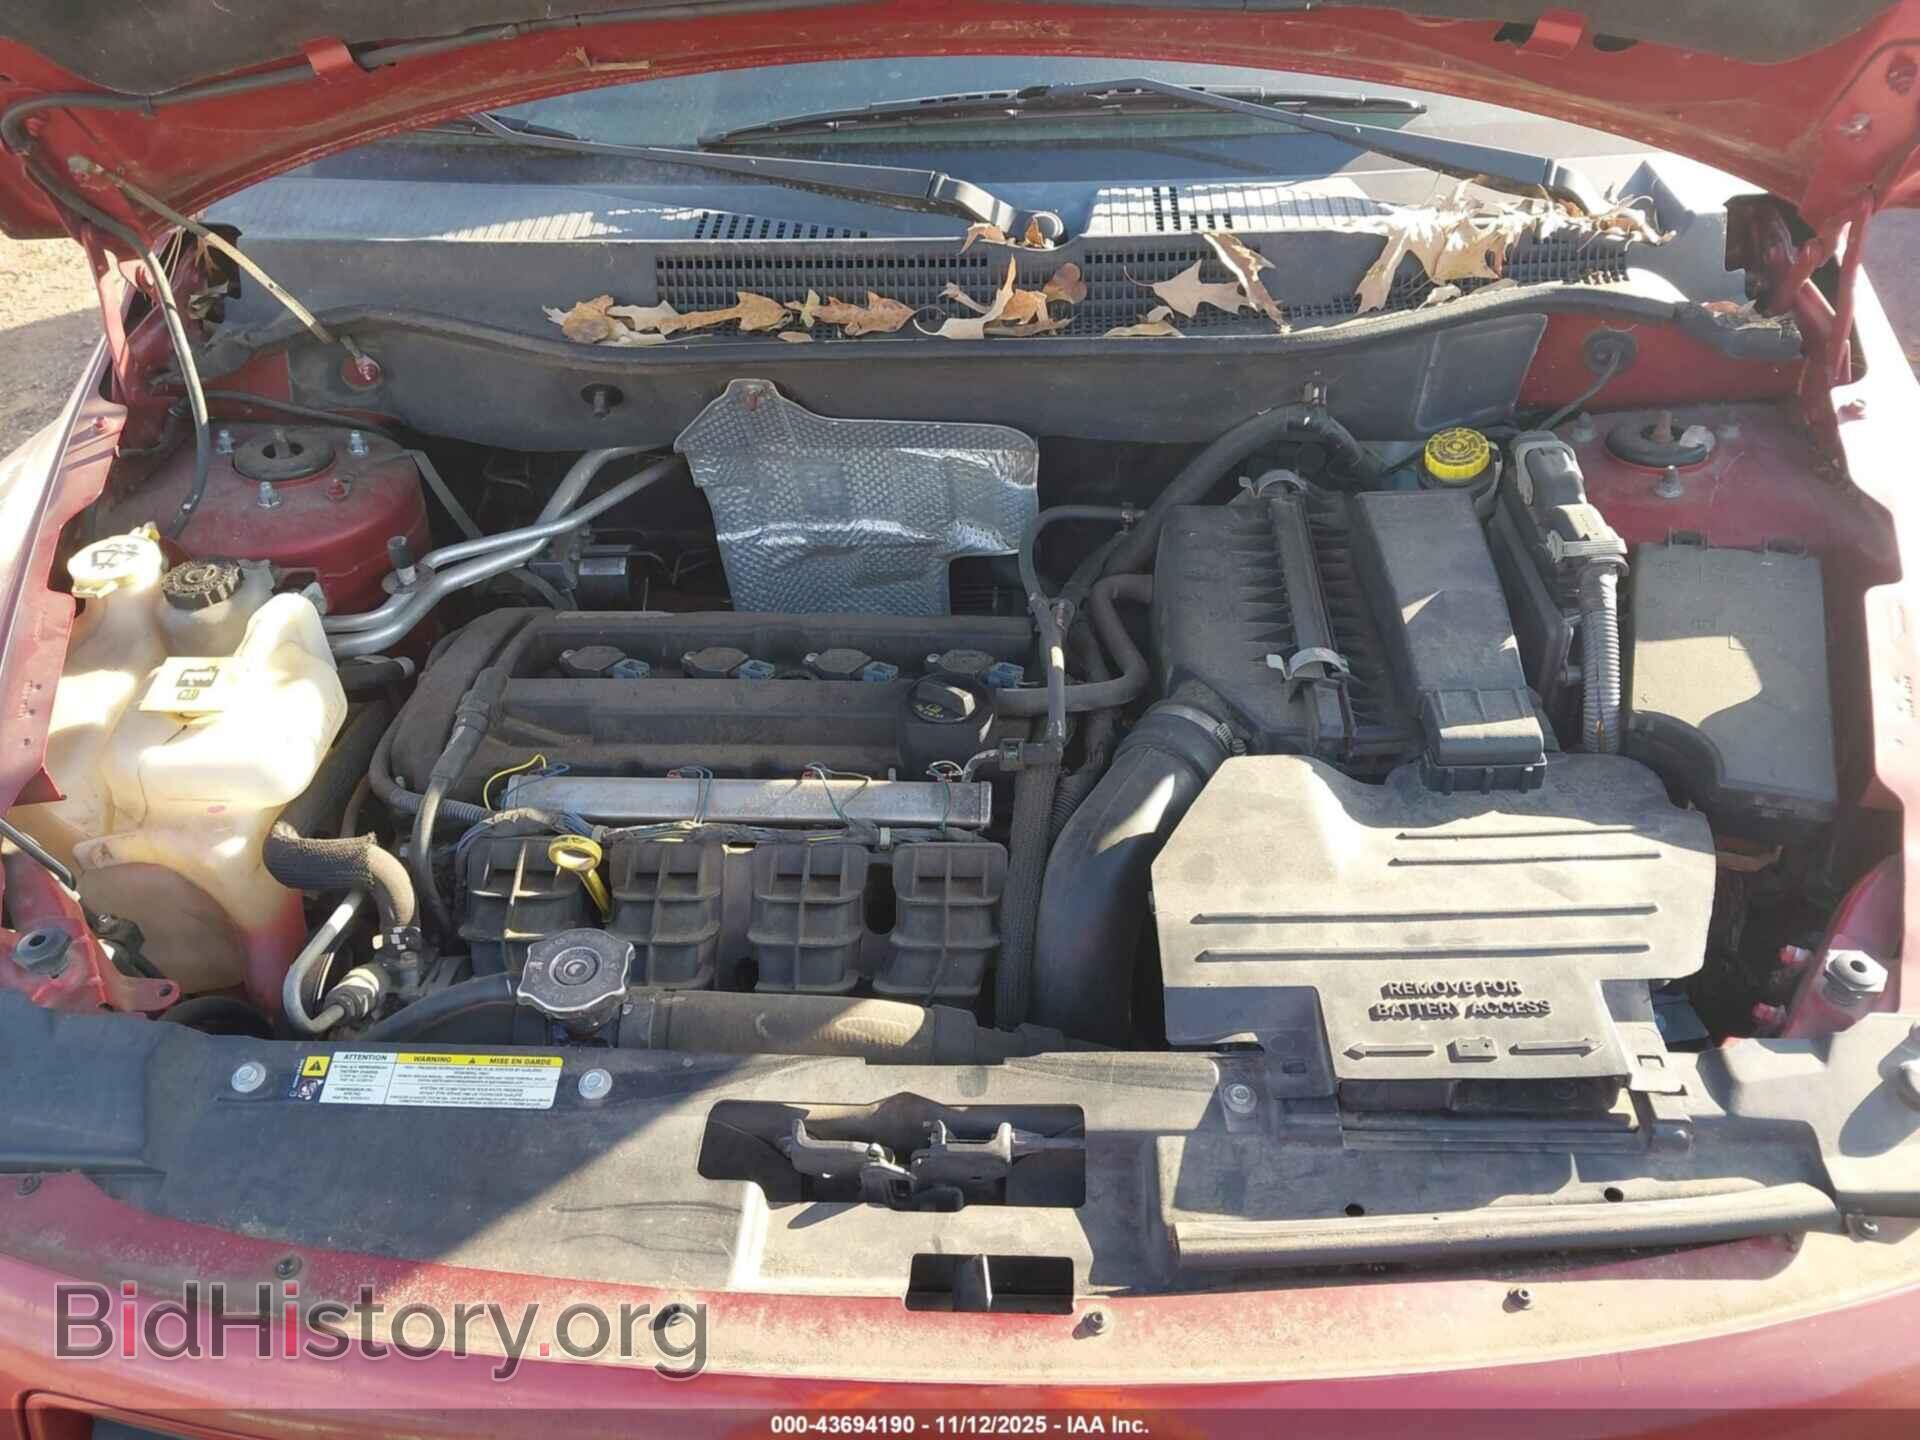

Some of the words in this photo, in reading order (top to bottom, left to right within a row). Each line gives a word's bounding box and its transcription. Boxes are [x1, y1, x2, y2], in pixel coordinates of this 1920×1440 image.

[1383, 981, 1475, 999] REMOVE
[1477, 980, 1522, 998] FOR
[1468, 1000, 1552, 1019] ACCESS
[343, 1053, 388, 1062] ATTENTION
[413, 1056, 453, 1064] WARNING
[489, 1057, 508, 1065] MISE
[524, 1058, 552, 1066] GARDE
